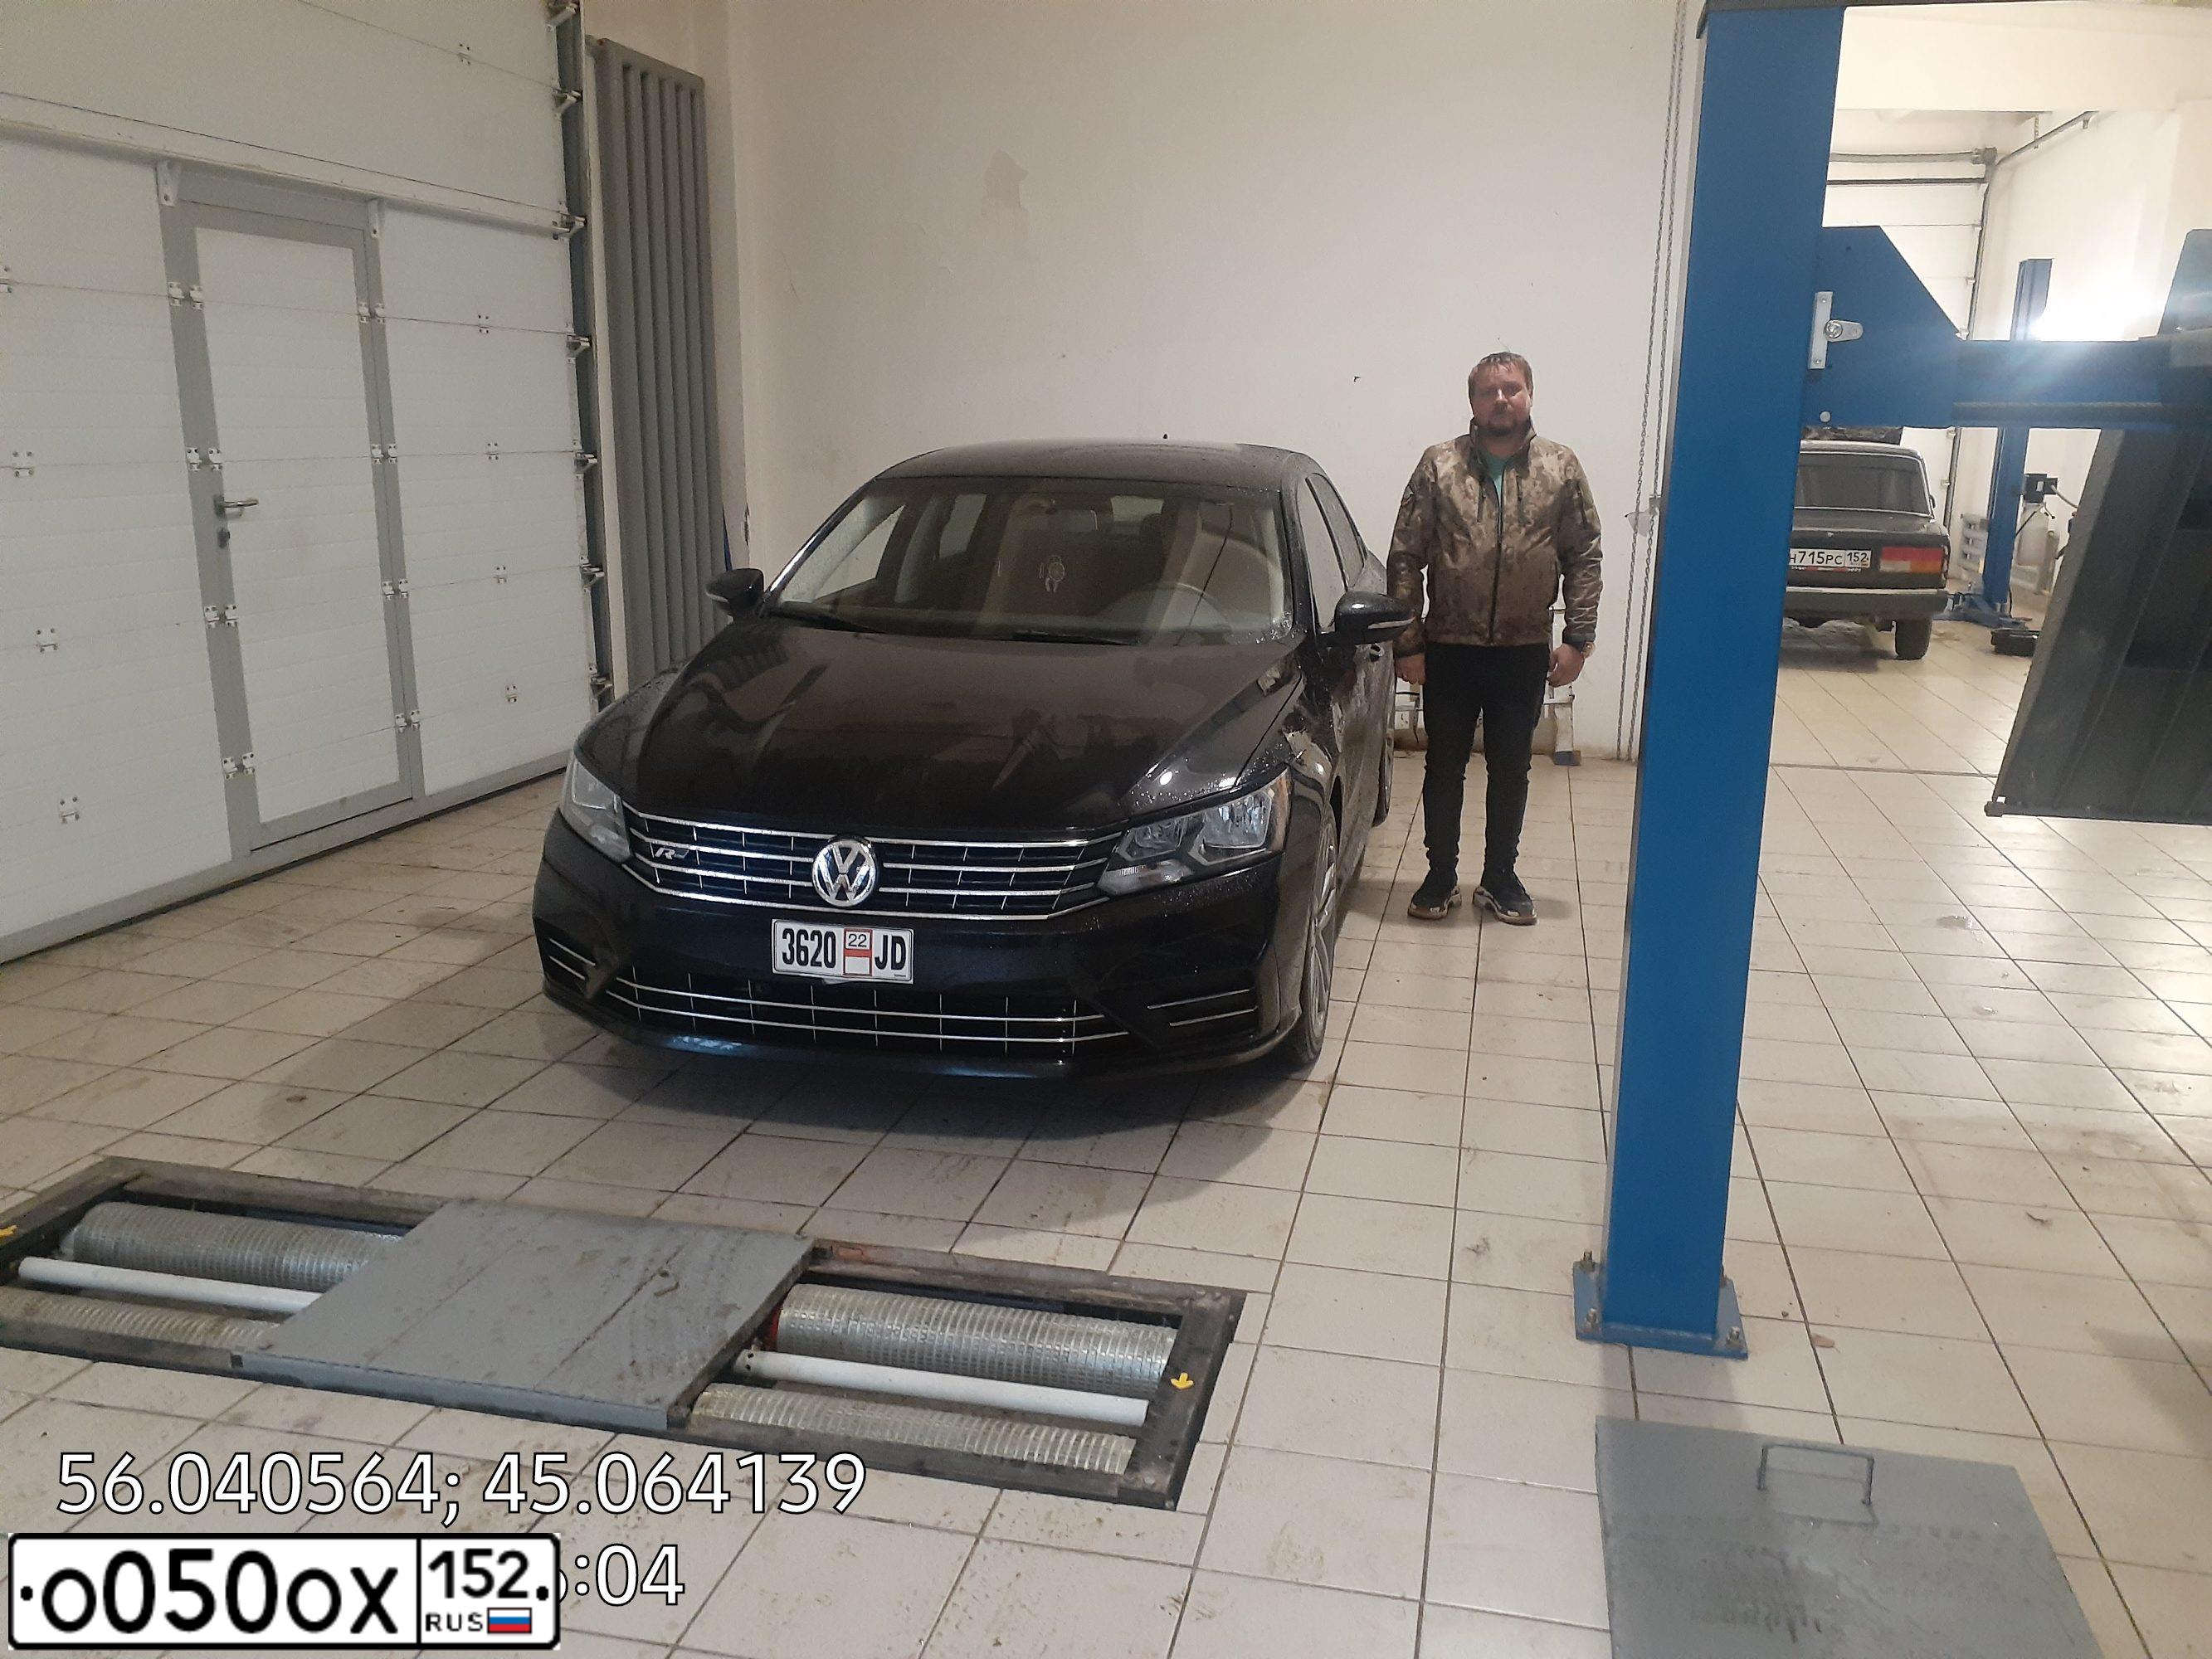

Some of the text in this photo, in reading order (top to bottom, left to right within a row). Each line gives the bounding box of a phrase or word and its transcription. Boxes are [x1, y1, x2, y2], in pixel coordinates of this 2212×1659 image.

[1847, 552, 1867, 562] 152
[782, 928, 907, 971] 3620 22 JD
